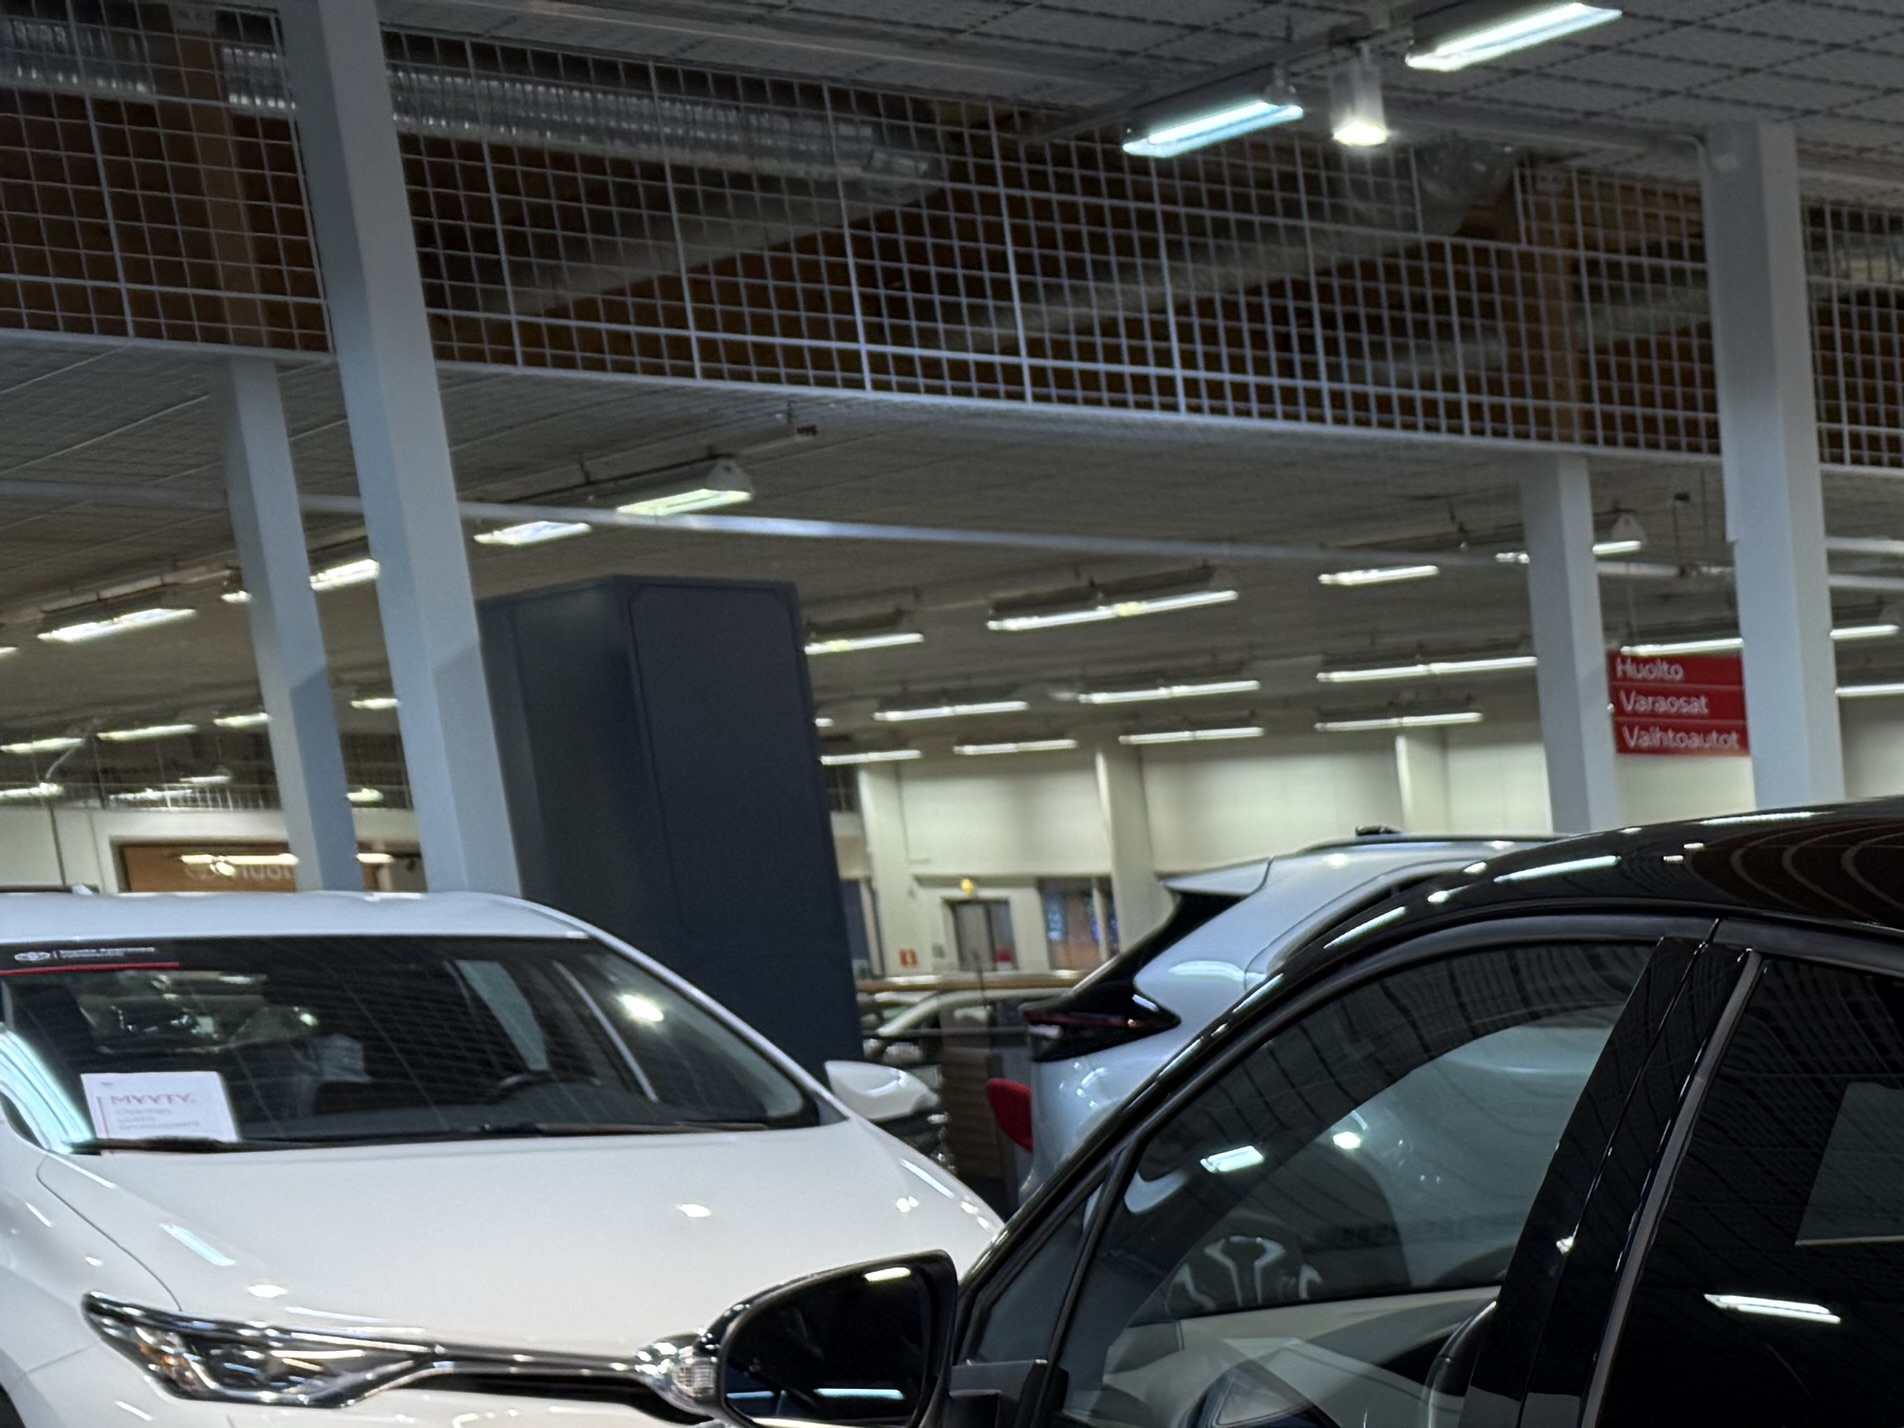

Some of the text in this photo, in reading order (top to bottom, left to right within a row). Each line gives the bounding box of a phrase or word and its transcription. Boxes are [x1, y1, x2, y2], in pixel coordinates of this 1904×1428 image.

[1616, 656, 1684, 680] Huolto
[1619, 689, 1709, 714] Varaosat
[1621, 724, 1740, 750] Vaihtoautot
